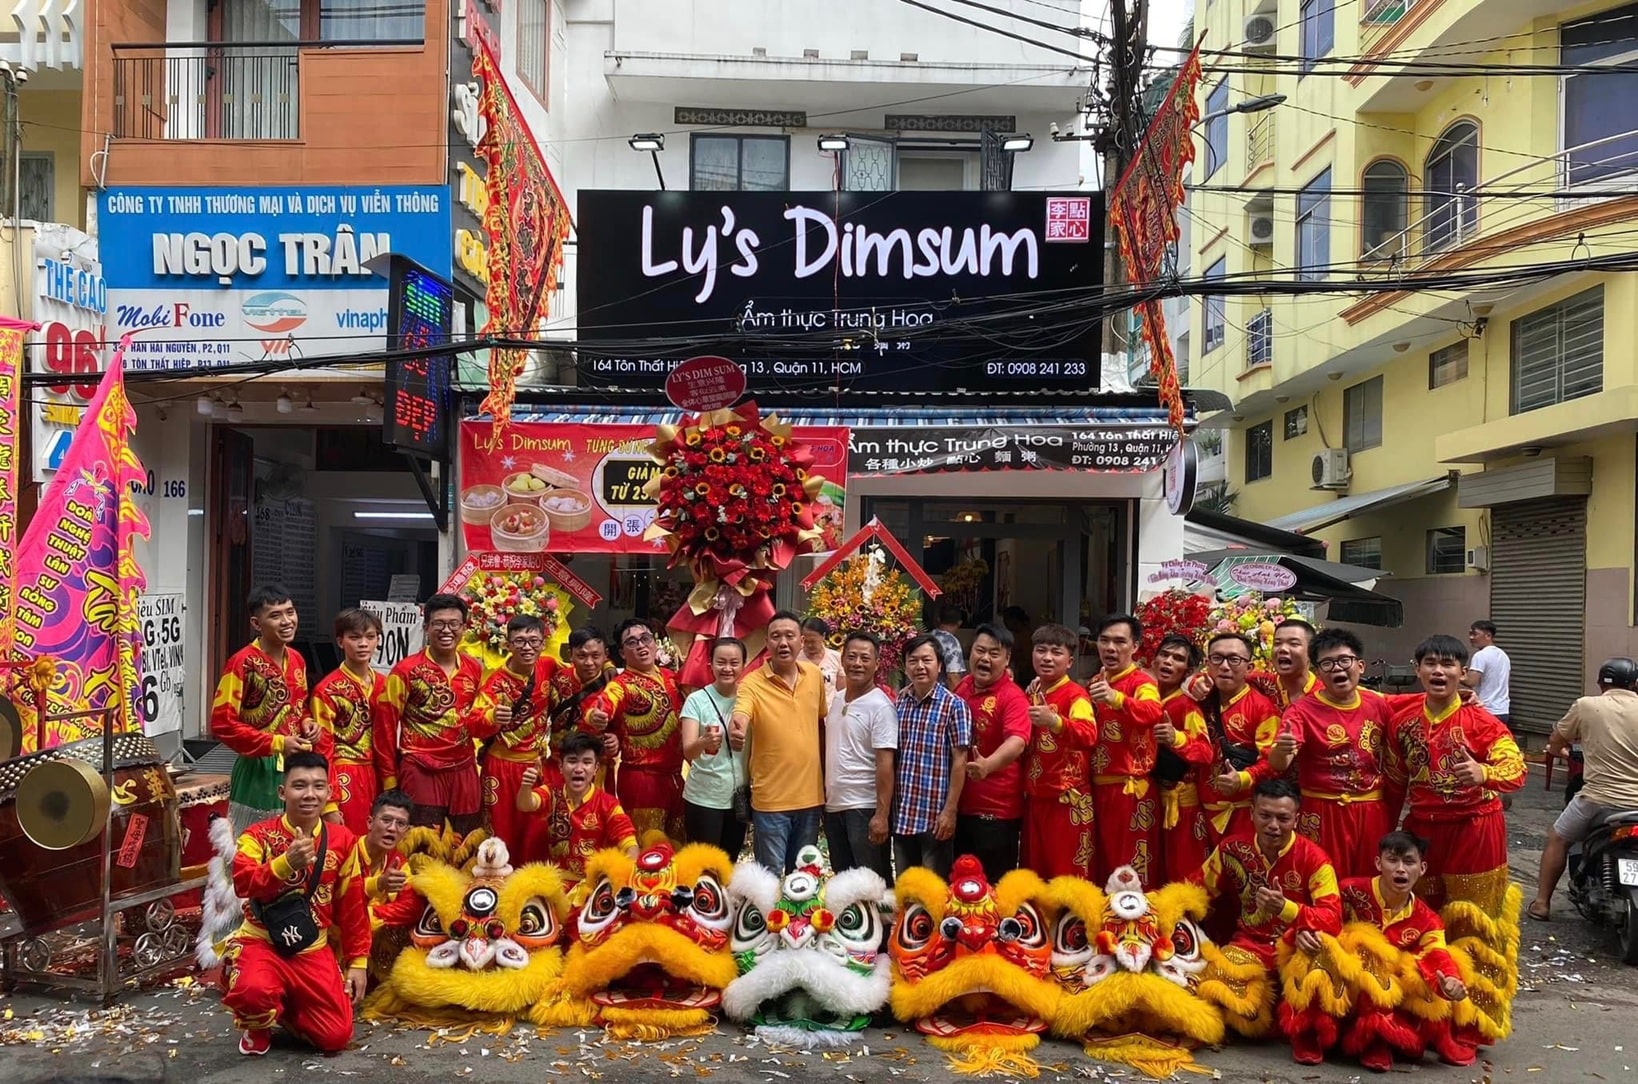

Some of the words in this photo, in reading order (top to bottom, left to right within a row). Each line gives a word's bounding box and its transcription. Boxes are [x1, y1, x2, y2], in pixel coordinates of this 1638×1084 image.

[108, 194, 144, 214] CÔNG
[149, 197, 164, 214] TY
[168, 197, 200, 214] TNHH
[205, 194, 255, 214] THƯƠNG
[260, 196, 283, 217] MẠI
[287, 192, 302, 214] VÀ
[307, 196, 336, 217] DỊCH
[340, 196, 356, 217] VỤ
[362, 188, 390, 213] VIỄN
[396, 194, 439, 213] THÔNG
[152, 231, 267, 285] NGỌC
[640, 204, 760, 304] Ly's
[784, 204, 1039, 279] Dimsum
[742, 300, 775, 328] Ẩm
[781, 306, 825, 331] thực
[832, 309, 885, 330] Trung
[892, 309, 933, 328] Hoa
[593, 360, 612, 371] 164
[614, 360, 636, 372] Tôn
[638, 359, 664, 372] Thất
[773, 362, 808, 376] Quận
[831, 362, 862, 374] HCM
[671, 372, 691, 383] LY'S
[692, 368, 713, 380] DIM
[714, 364, 736, 376] SUM
[986, 362, 1005, 375] ĐT:
[1008, 362, 1036, 375] 0908
[1039, 362, 1060, 375] 241
[1064, 362, 1086, 375] 233
[510, 433, 572, 452] Dimsum
[1072, 431, 1096, 440] 164
[1099, 431, 1123, 440] Tôn
[1126, 429, 1156, 440] Thất
[886, 438, 938, 456] thực
[944, 437, 1008, 452] Trung
[1014, 434, 1063, 447] Hoa
[1072, 441, 1106, 454] Phường
[1126, 443, 1150, 454] Quận
[865, 457, 934, 470] 各種小炒
[1072, 455, 1092, 465] ĐT:
[1096, 455, 1128, 466] 0908
[1132, 456, 1157, 466] 241
[628, 462, 660, 480] GIẢM
[164, 480, 186, 498] 166
[610, 482, 631, 500] TỪ
[67, 501, 94, 523] ĐOÀ
[48, 534, 86, 562] THUẬT
[45, 555, 70, 575] LÂN
[39, 575, 58, 590] SƯ
[20, 587, 56, 612] RỒNG
[137, 601, 152, 618] iêu
[156, 598, 175, 616] SIM
[16, 607, 42, 628] TÂM
[385, 605, 417, 624] Phẩm
[15, 630, 34, 648] OA
[141, 616, 180, 646] G,5G
